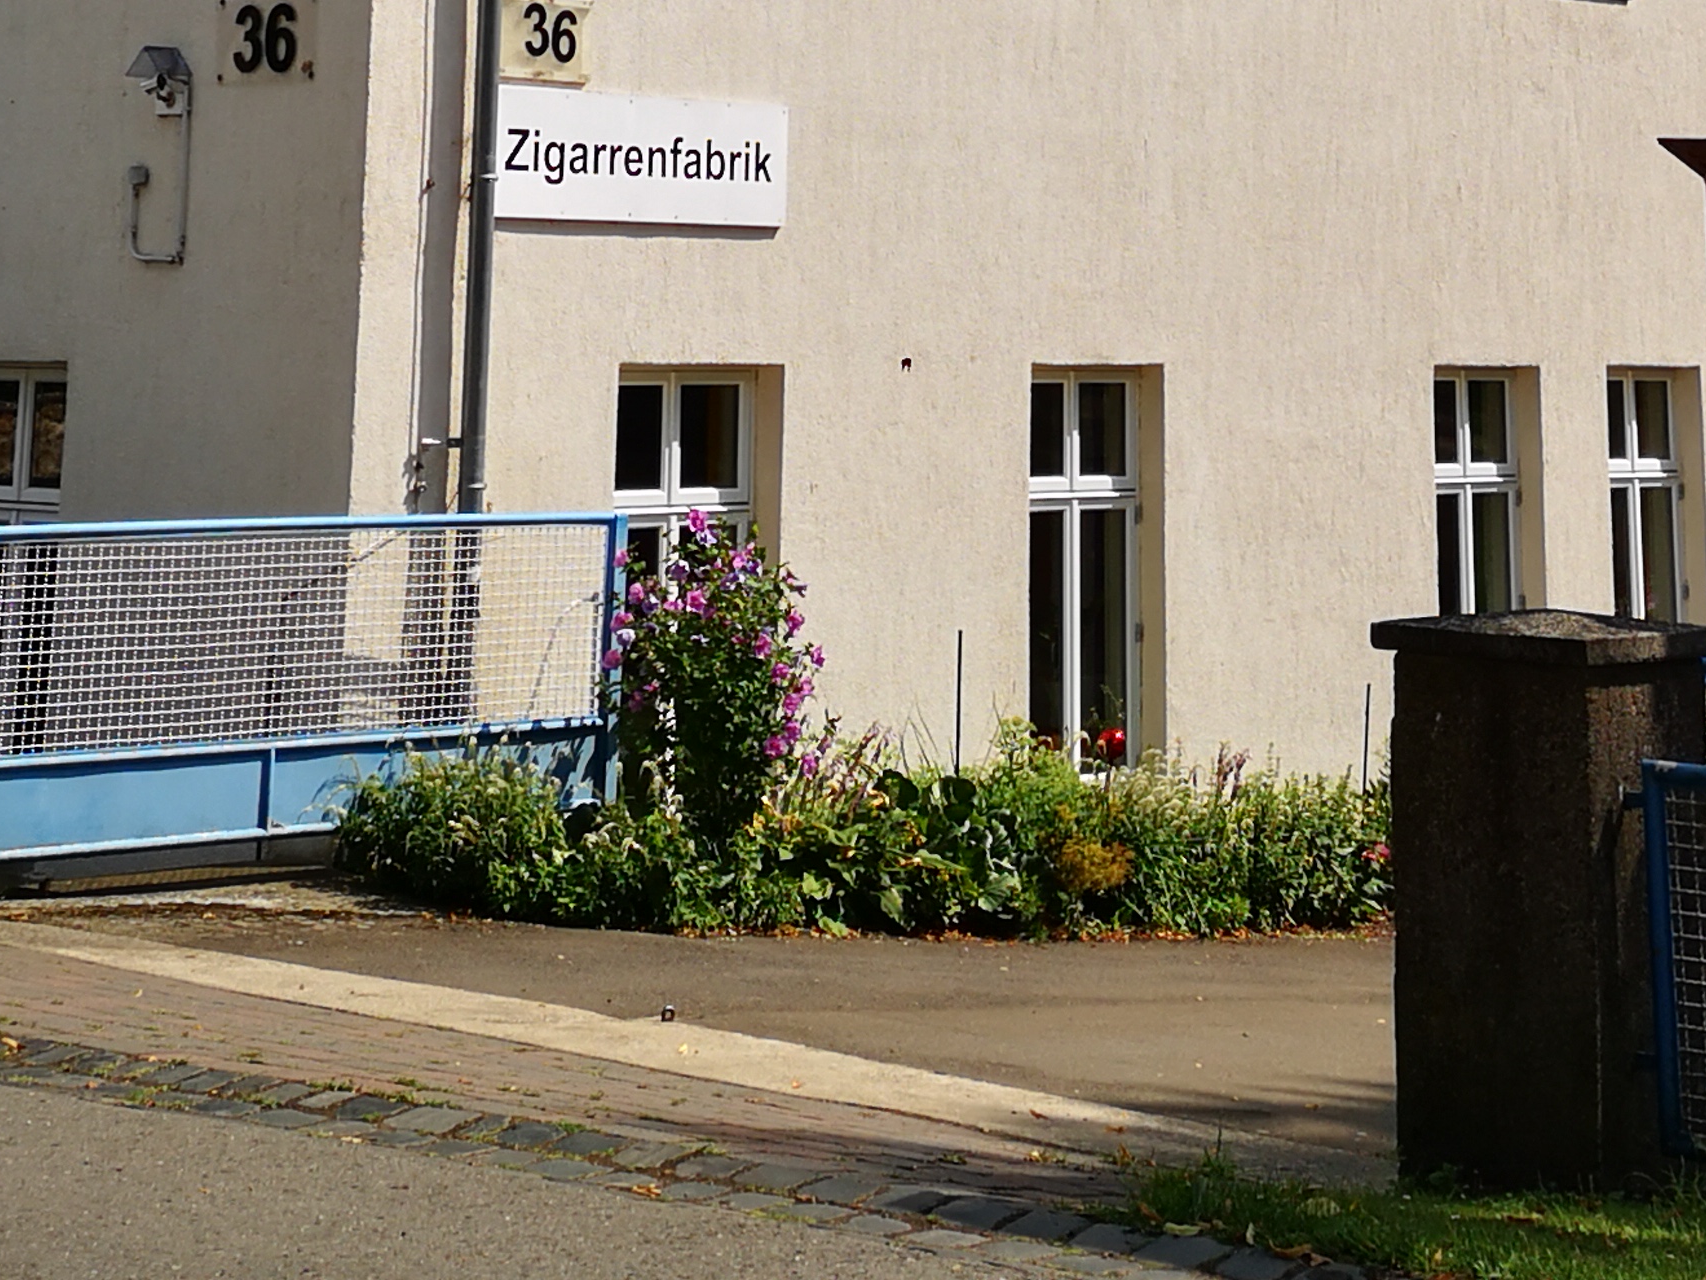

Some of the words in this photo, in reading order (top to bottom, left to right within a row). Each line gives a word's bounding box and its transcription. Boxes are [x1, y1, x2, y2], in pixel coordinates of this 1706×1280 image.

[233, 3, 298, 74] 36
[524, 3, 578, 63] 36
[504, 128, 772, 184] Zigarrenfabrik
